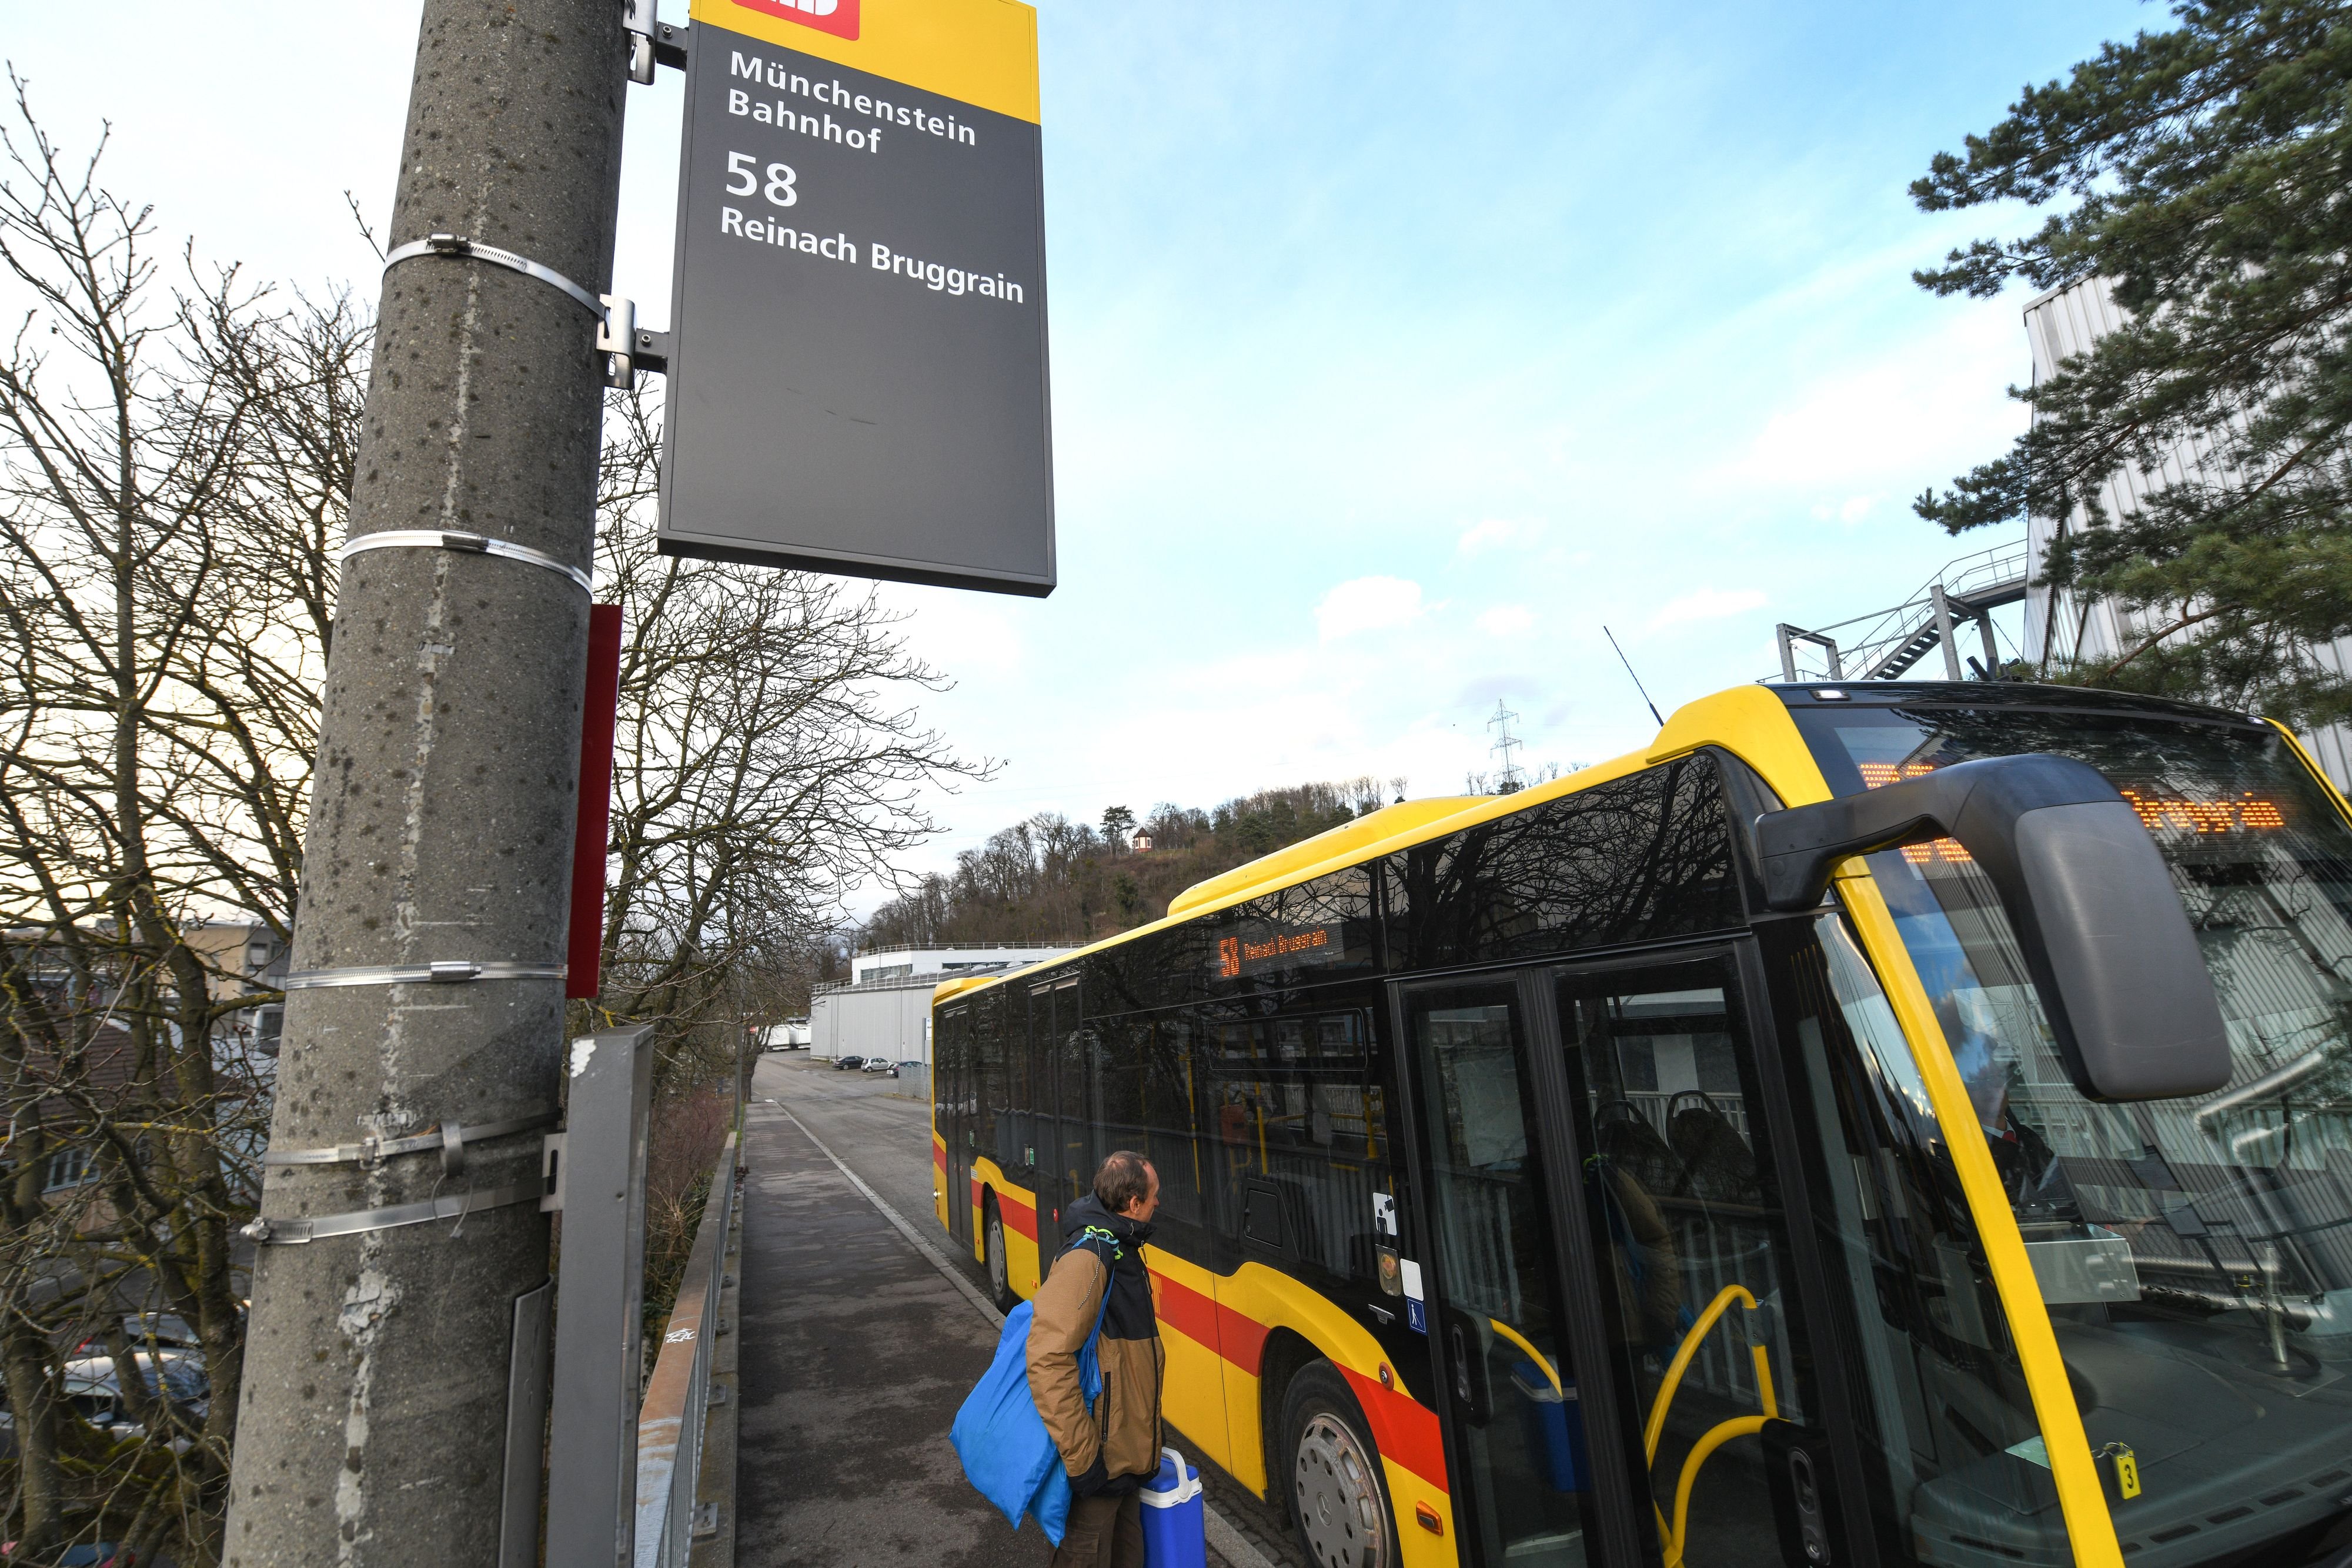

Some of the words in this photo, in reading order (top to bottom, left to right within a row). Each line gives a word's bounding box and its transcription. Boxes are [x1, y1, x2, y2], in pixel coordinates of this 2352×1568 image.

[728, 88, 881, 153] Bahnhof
[730, 51, 976, 146] Münchenstein
[725, 151, 798, 207] 58
[721, 206, 857, 264] Reinach
[871, 242, 1024, 304] Bruggrain
[1220, 937, 1240, 977] 58
[1244, 937, 1276, 960] Reinach
[2124, 1463, 2134, 1489] 3
